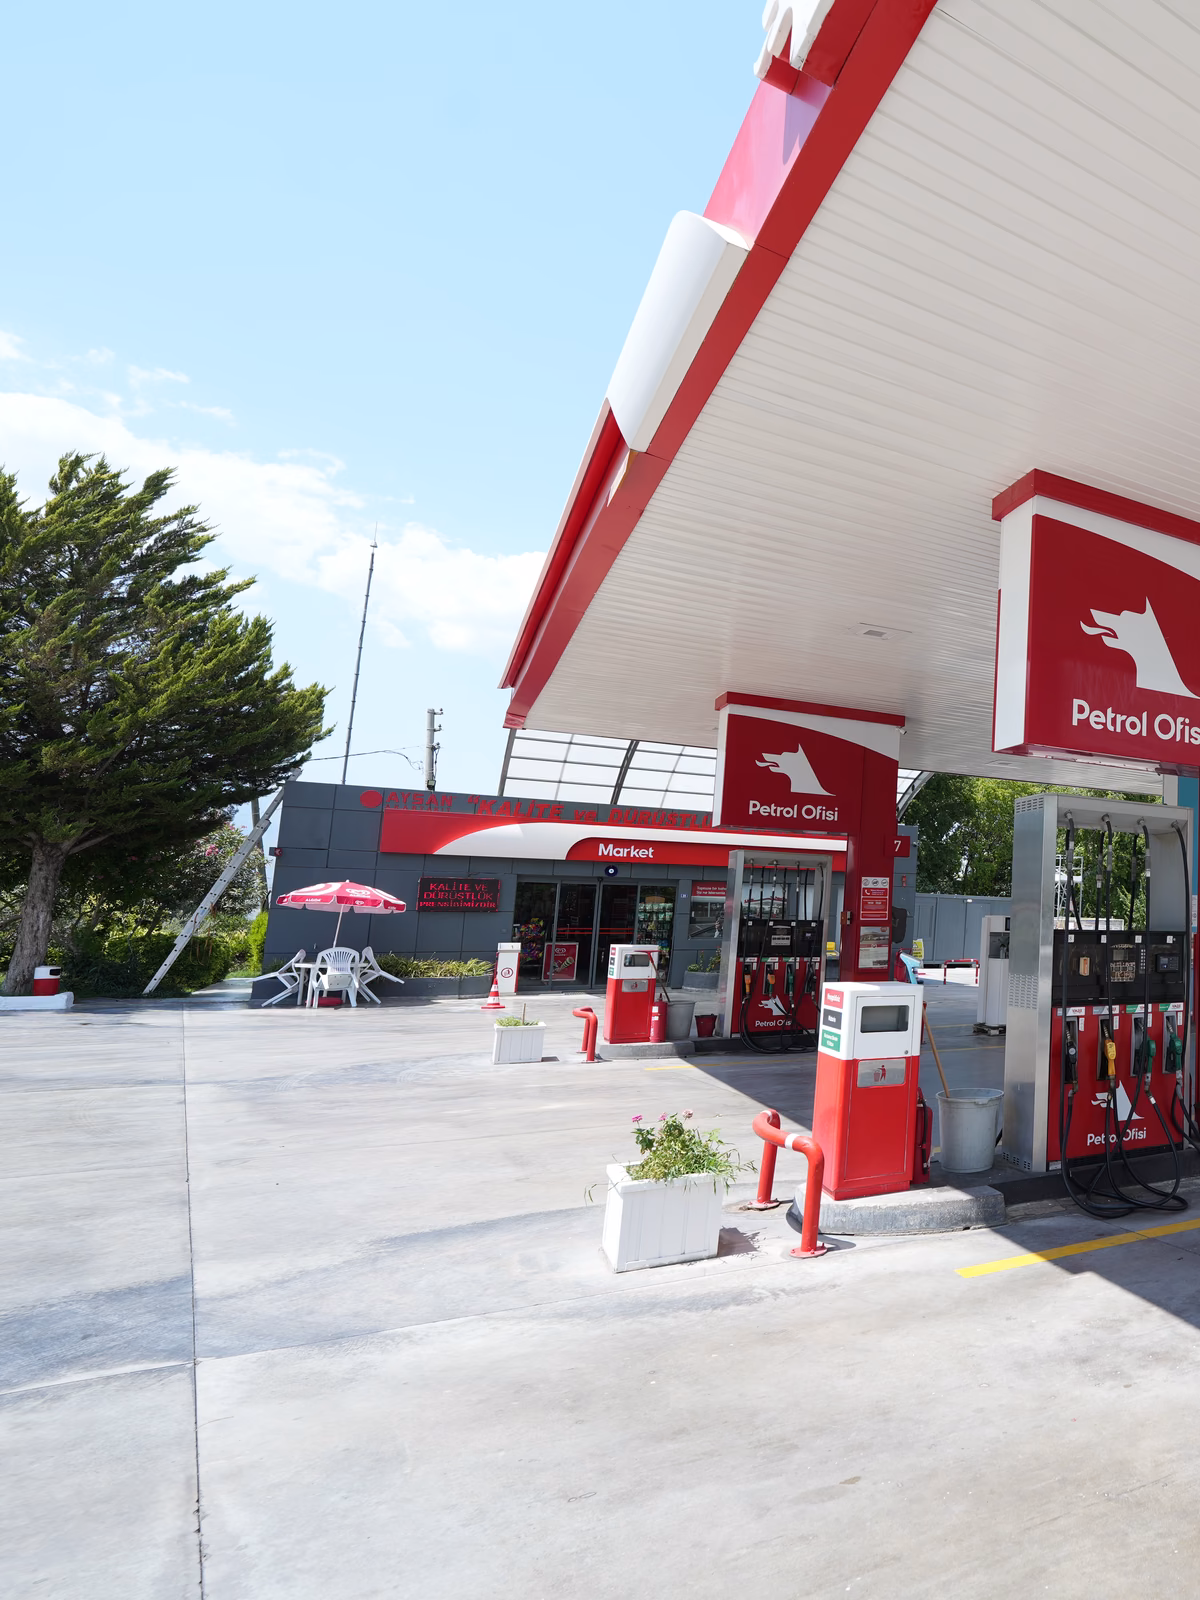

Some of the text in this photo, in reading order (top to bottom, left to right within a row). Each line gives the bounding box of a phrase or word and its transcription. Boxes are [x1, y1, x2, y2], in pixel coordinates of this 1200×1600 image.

[1072, 698, 1147, 737] Petrol
[386, 791, 453, 807] AYSAN
[608, 808, 713, 829] DÜRÜSTLÜ
[748, 800, 839, 822] Petrol Ofisi
[598, 843, 654, 859] Market
[893, 840, 902, 852] 7
[429, 881, 488, 891] KALİTE VE
[1087, 1133, 1118, 1146] Peto
